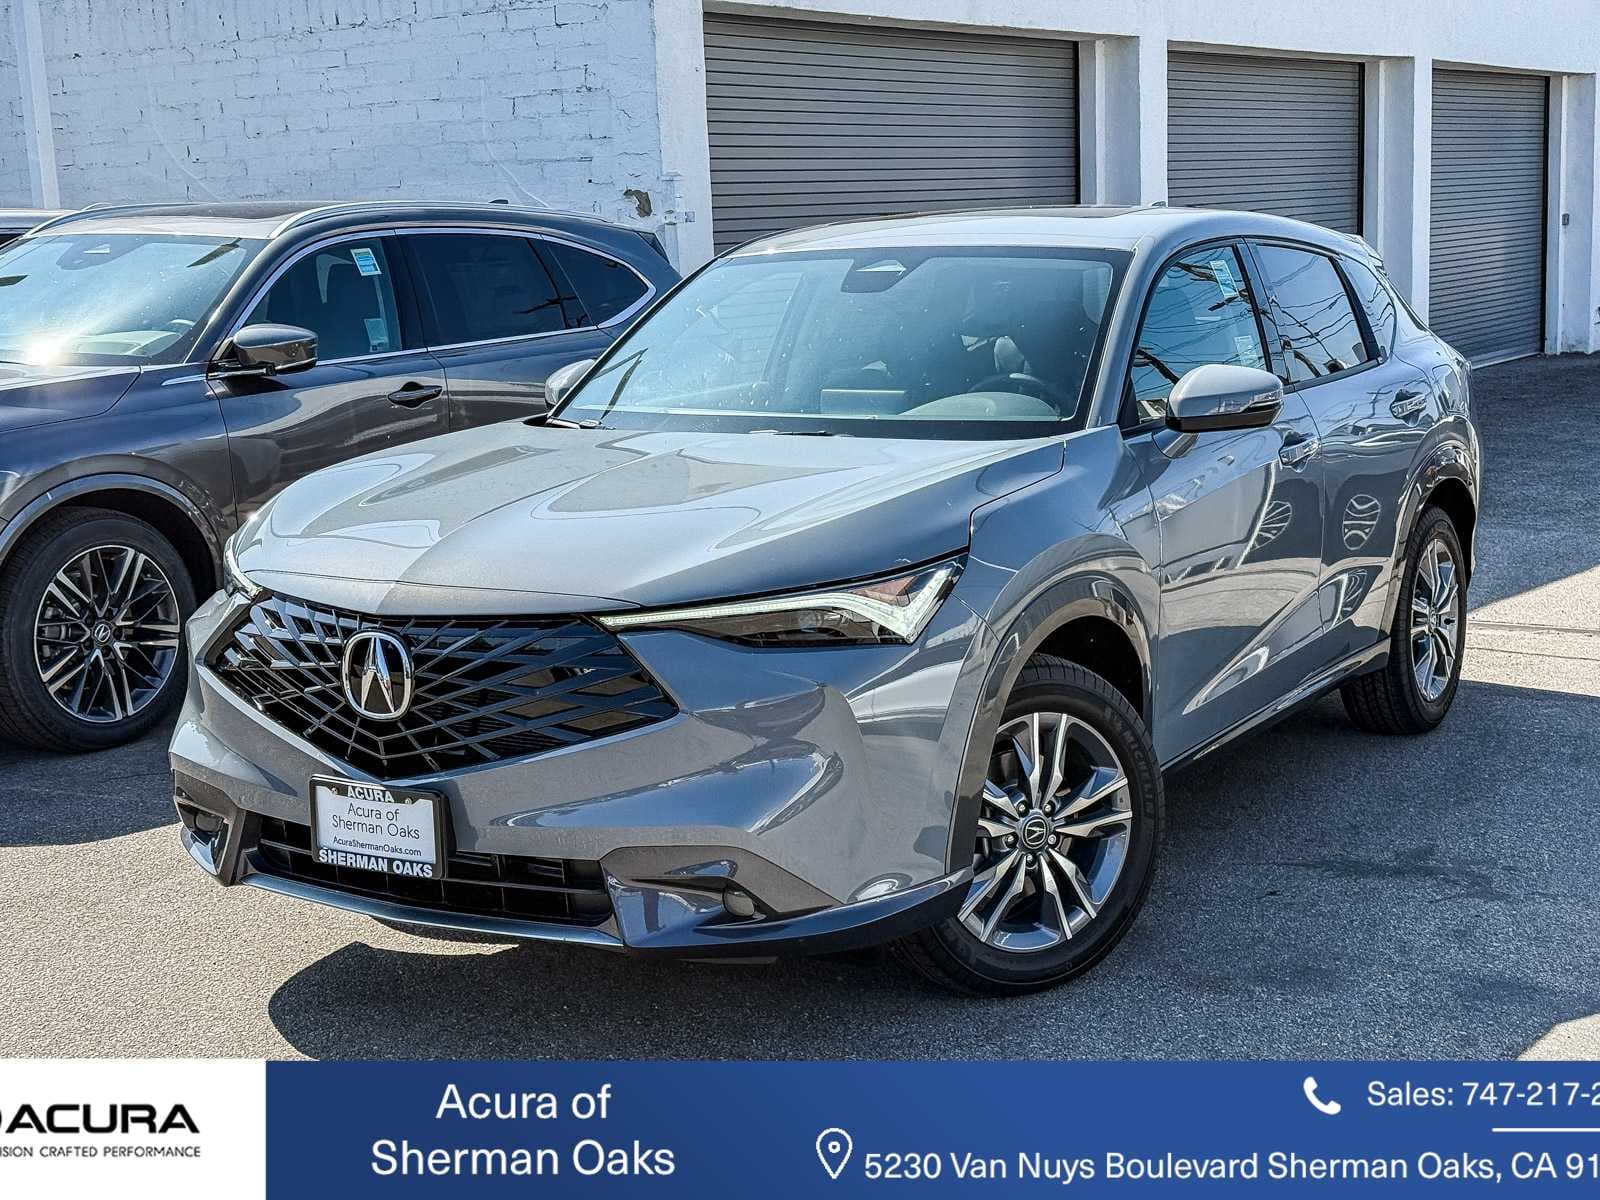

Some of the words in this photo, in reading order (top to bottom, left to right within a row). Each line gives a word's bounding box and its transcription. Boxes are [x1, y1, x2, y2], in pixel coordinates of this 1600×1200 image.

[347, 785, 395, 803] ACURA
[347, 802, 382, 820] Acura
[386, 809, 400, 821] of
[332, 815, 383, 835] Sherman
[387, 823, 420, 839] Oaks
[333, 835, 422, 857] AcuraShermanOaks.com
[318, 848, 388, 872] SHERMAN
[392, 860, 433, 877] OAKS
